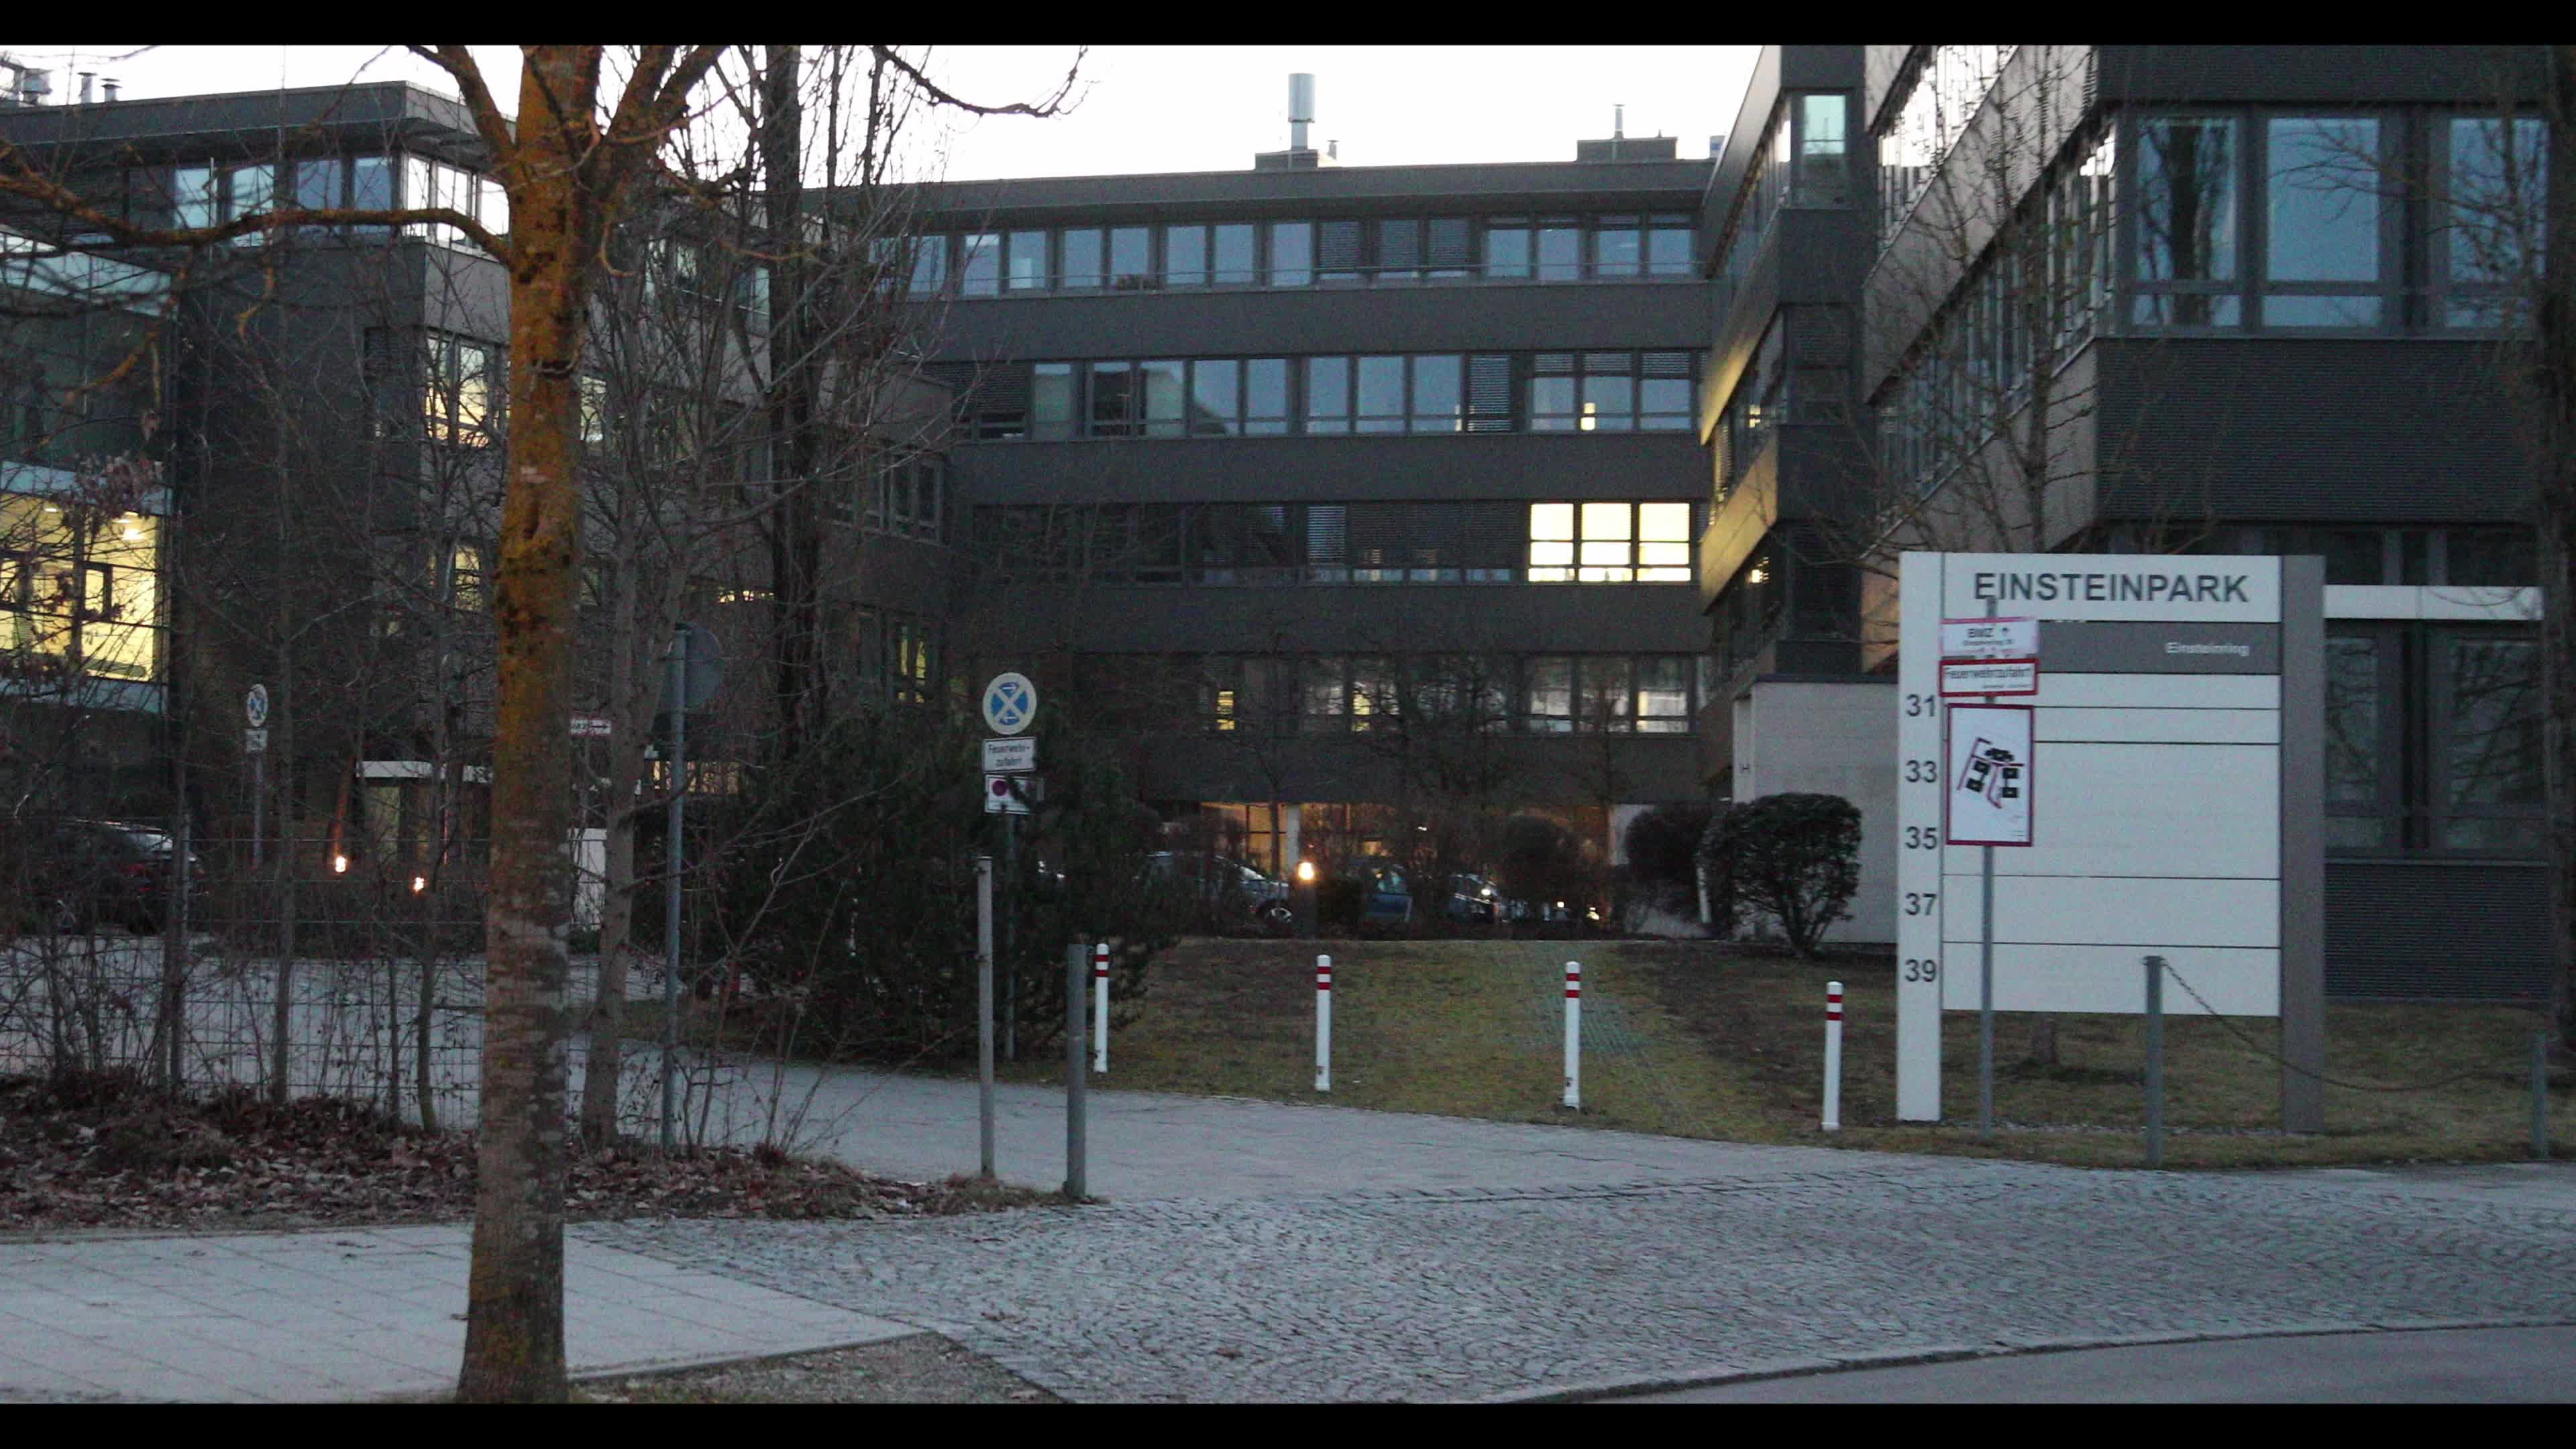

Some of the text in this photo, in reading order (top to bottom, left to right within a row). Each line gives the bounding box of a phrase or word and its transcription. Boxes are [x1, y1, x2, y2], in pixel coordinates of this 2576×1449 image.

[1974, 572, 2249, 602] EINSTEINPARK
[1906, 694, 1936, 717] 31
[1905, 760, 1937, 784] 33
[1905, 826, 1937, 850] 35
[1905, 893, 1937, 916] 37
[1905, 959, 1937, 983] 39
